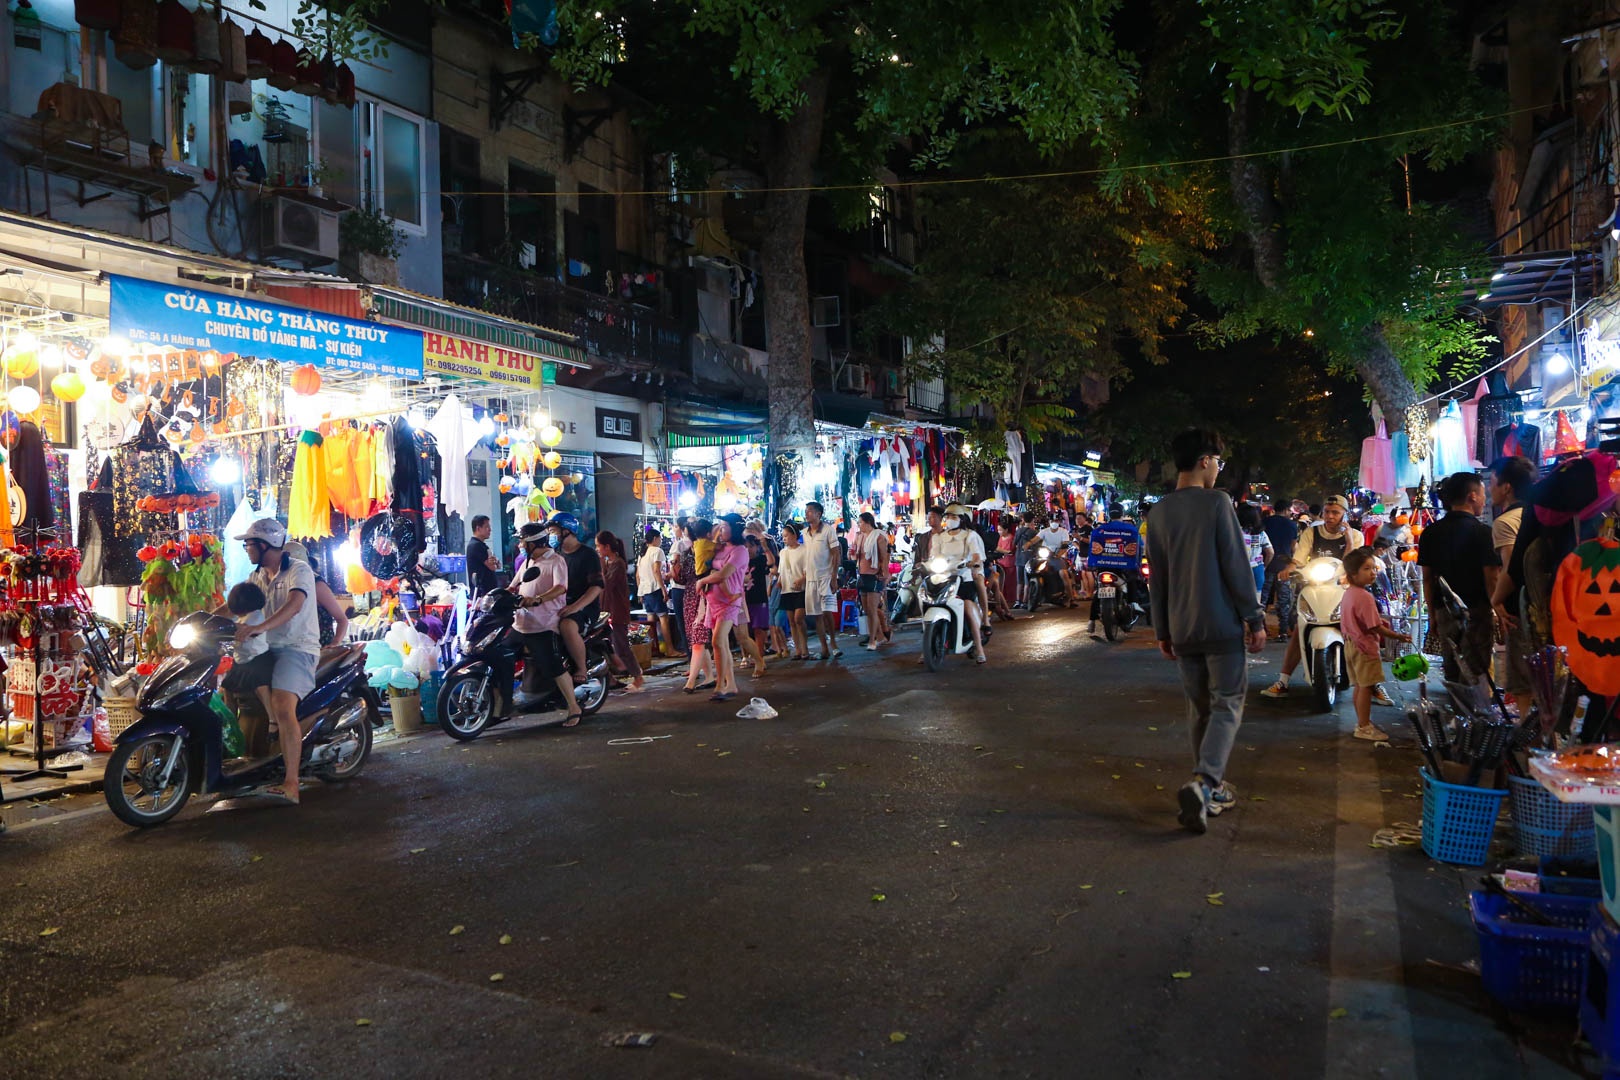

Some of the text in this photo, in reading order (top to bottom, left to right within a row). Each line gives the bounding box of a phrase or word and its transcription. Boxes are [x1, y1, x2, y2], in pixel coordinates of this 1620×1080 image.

[164, 291, 211, 314] CỬA
[217, 301, 274, 324] HÀNG
[345, 326, 388, 343] THÚY
[171, 334, 195, 346] HÀNG
[205, 320, 250, 341] CHUYÊN
[270, 329, 298, 348] VÀNG
[299, 335, 317, 350] MÃ
[325, 339, 340, 356] SỰ
[341, 342, 362, 357] KIỆN
